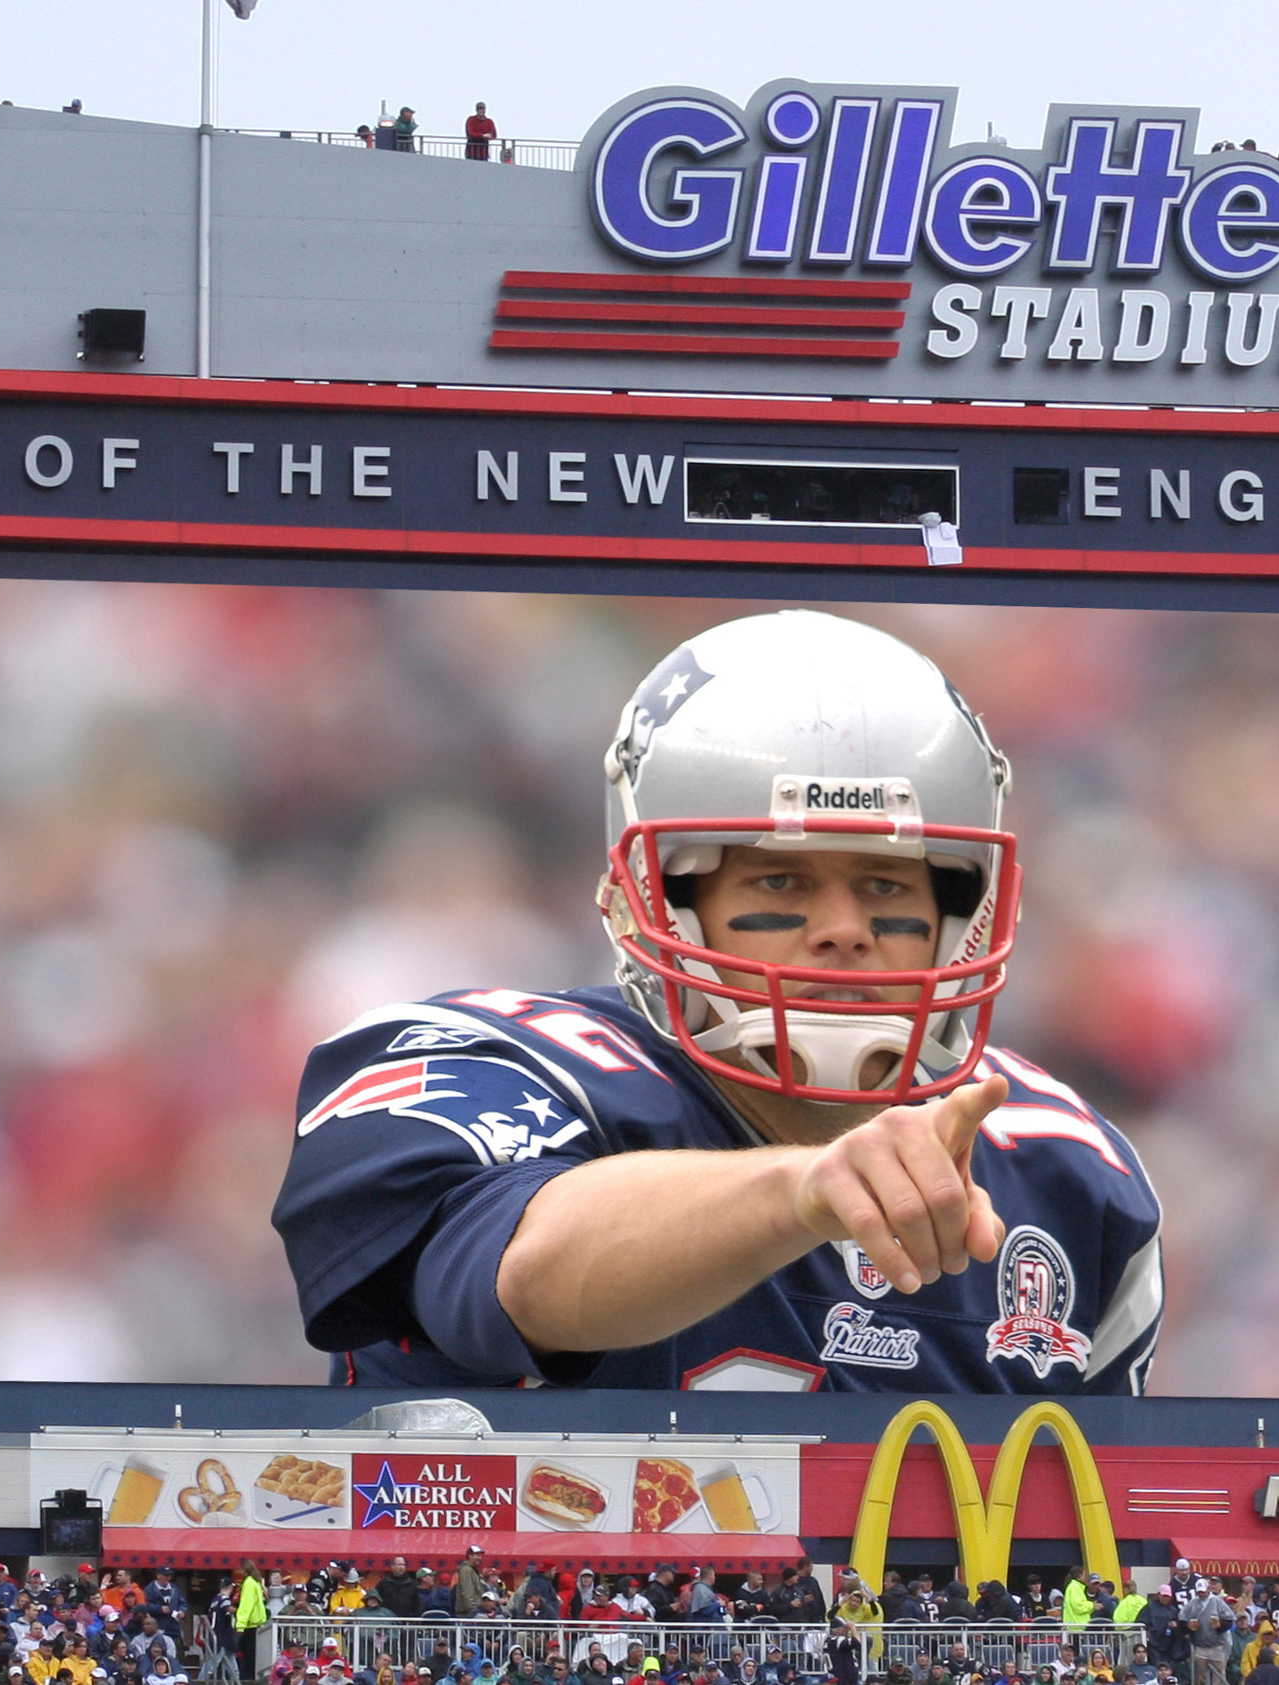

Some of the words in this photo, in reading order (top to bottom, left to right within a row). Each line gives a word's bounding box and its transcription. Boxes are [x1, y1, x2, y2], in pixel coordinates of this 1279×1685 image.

[24, 434, 140, 488] OF
[213, 441, 393, 498] THE
[477, 449, 676, 505] NEW
[806, 783, 885, 811] Riddell
[1017, 1260, 1051, 1318] 50
[1011, 1317, 1055, 1335] SEASONS
[827, 1320, 915, 1360] Patriots
[417, 1462, 471, 1484] ALL
[373, 1484, 514, 1507] AMERICAN
[393, 1508, 497, 1530] EATERY
